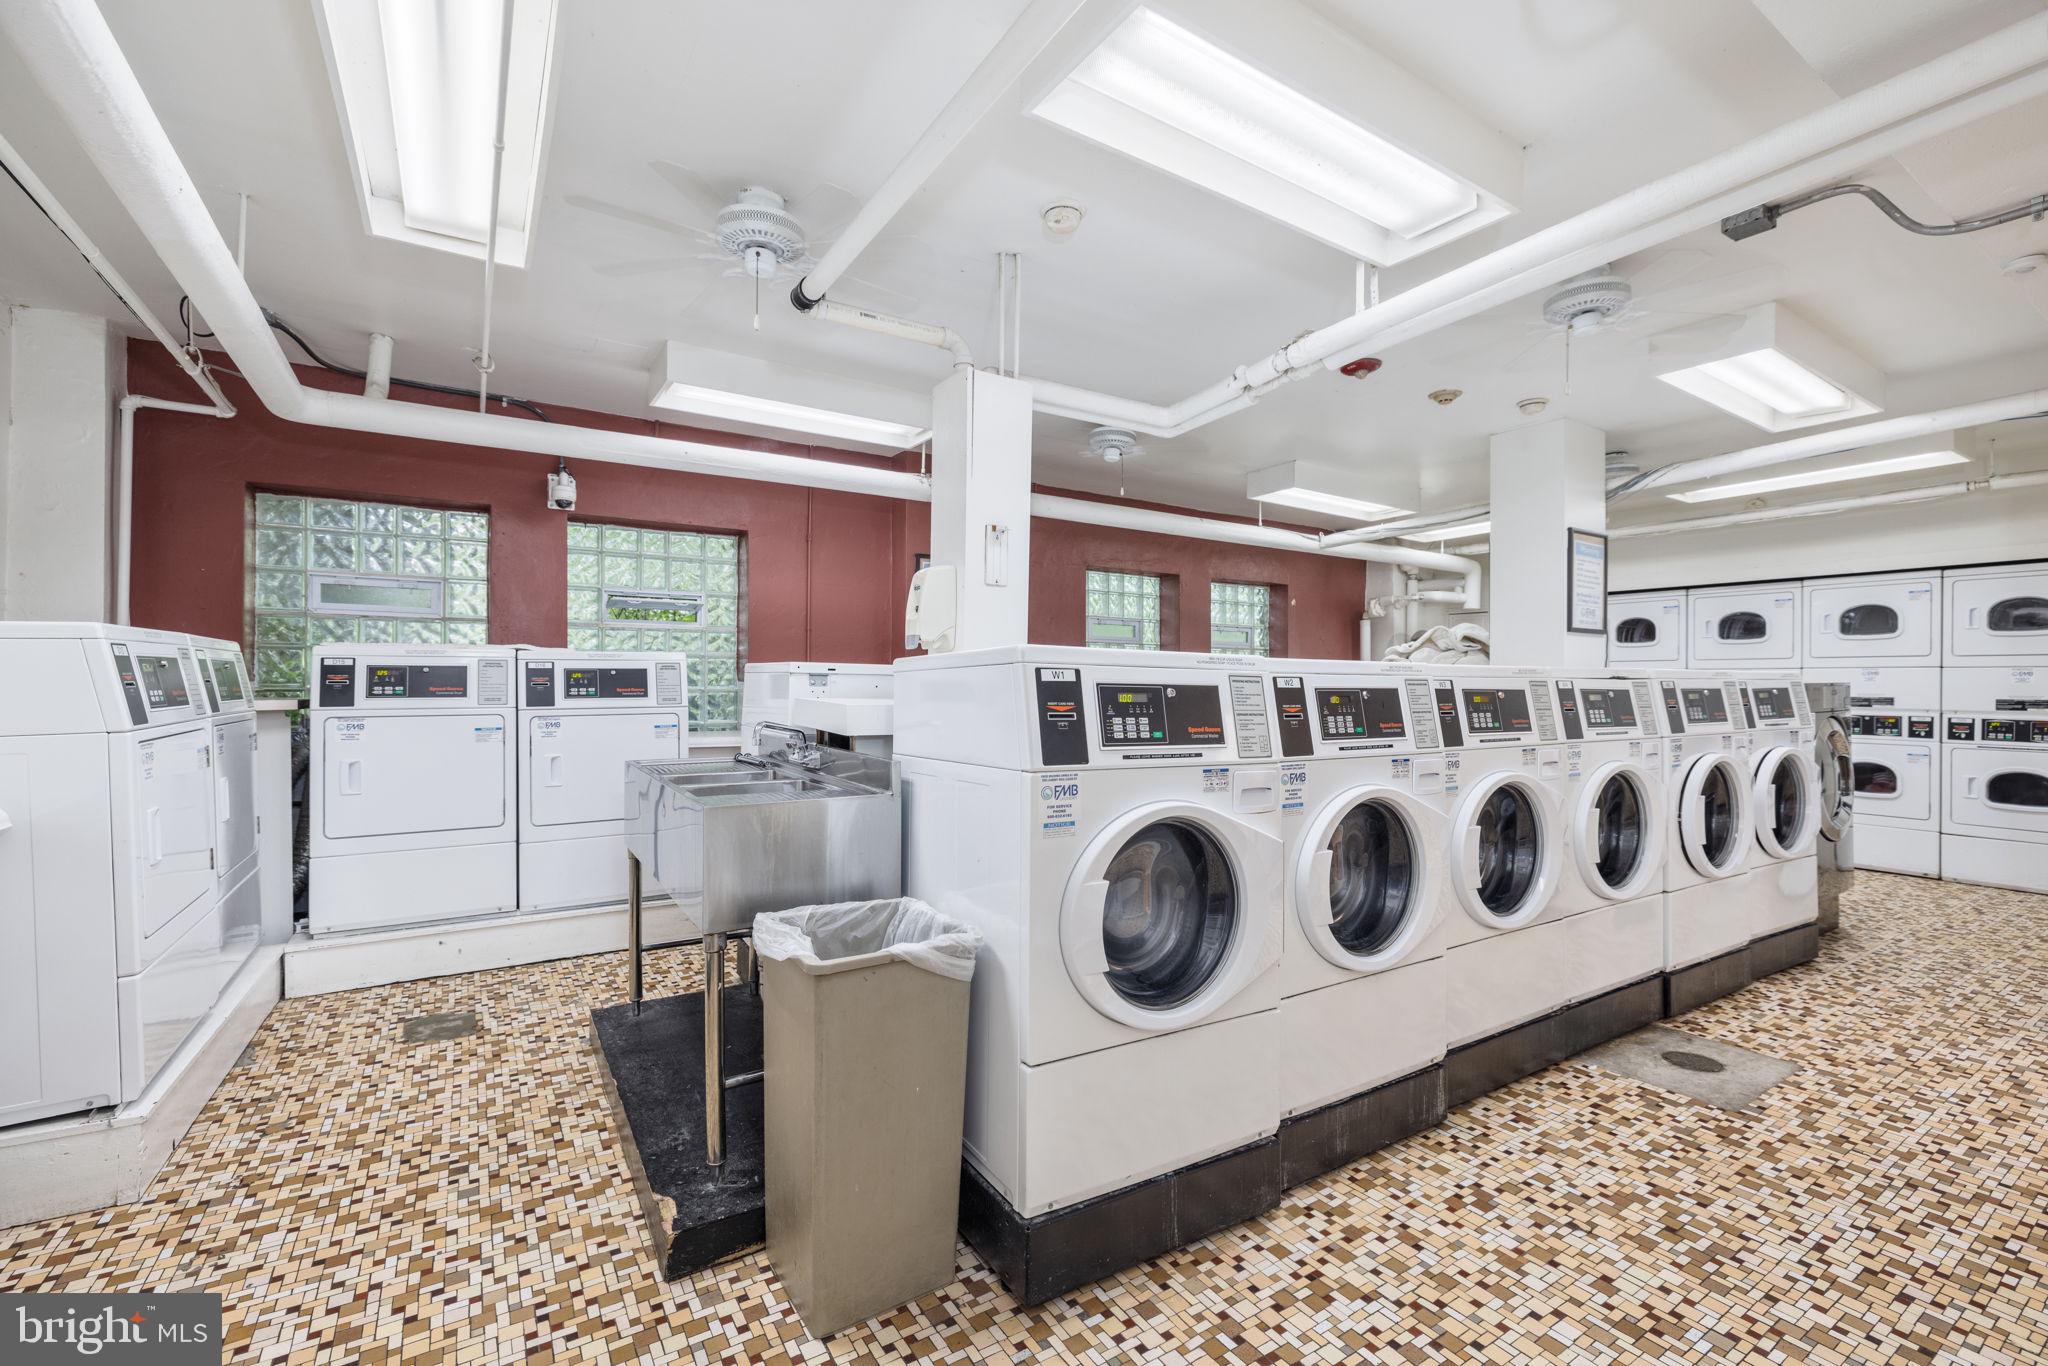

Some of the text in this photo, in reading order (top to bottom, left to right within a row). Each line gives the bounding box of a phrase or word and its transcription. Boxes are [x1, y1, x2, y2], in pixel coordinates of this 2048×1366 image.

[1051, 670, 1065, 680] W1
[1283, 679, 1295, 687] W2
[1290, 772, 1306, 785] FMB
[1054, 784, 1079, 800] FMB
